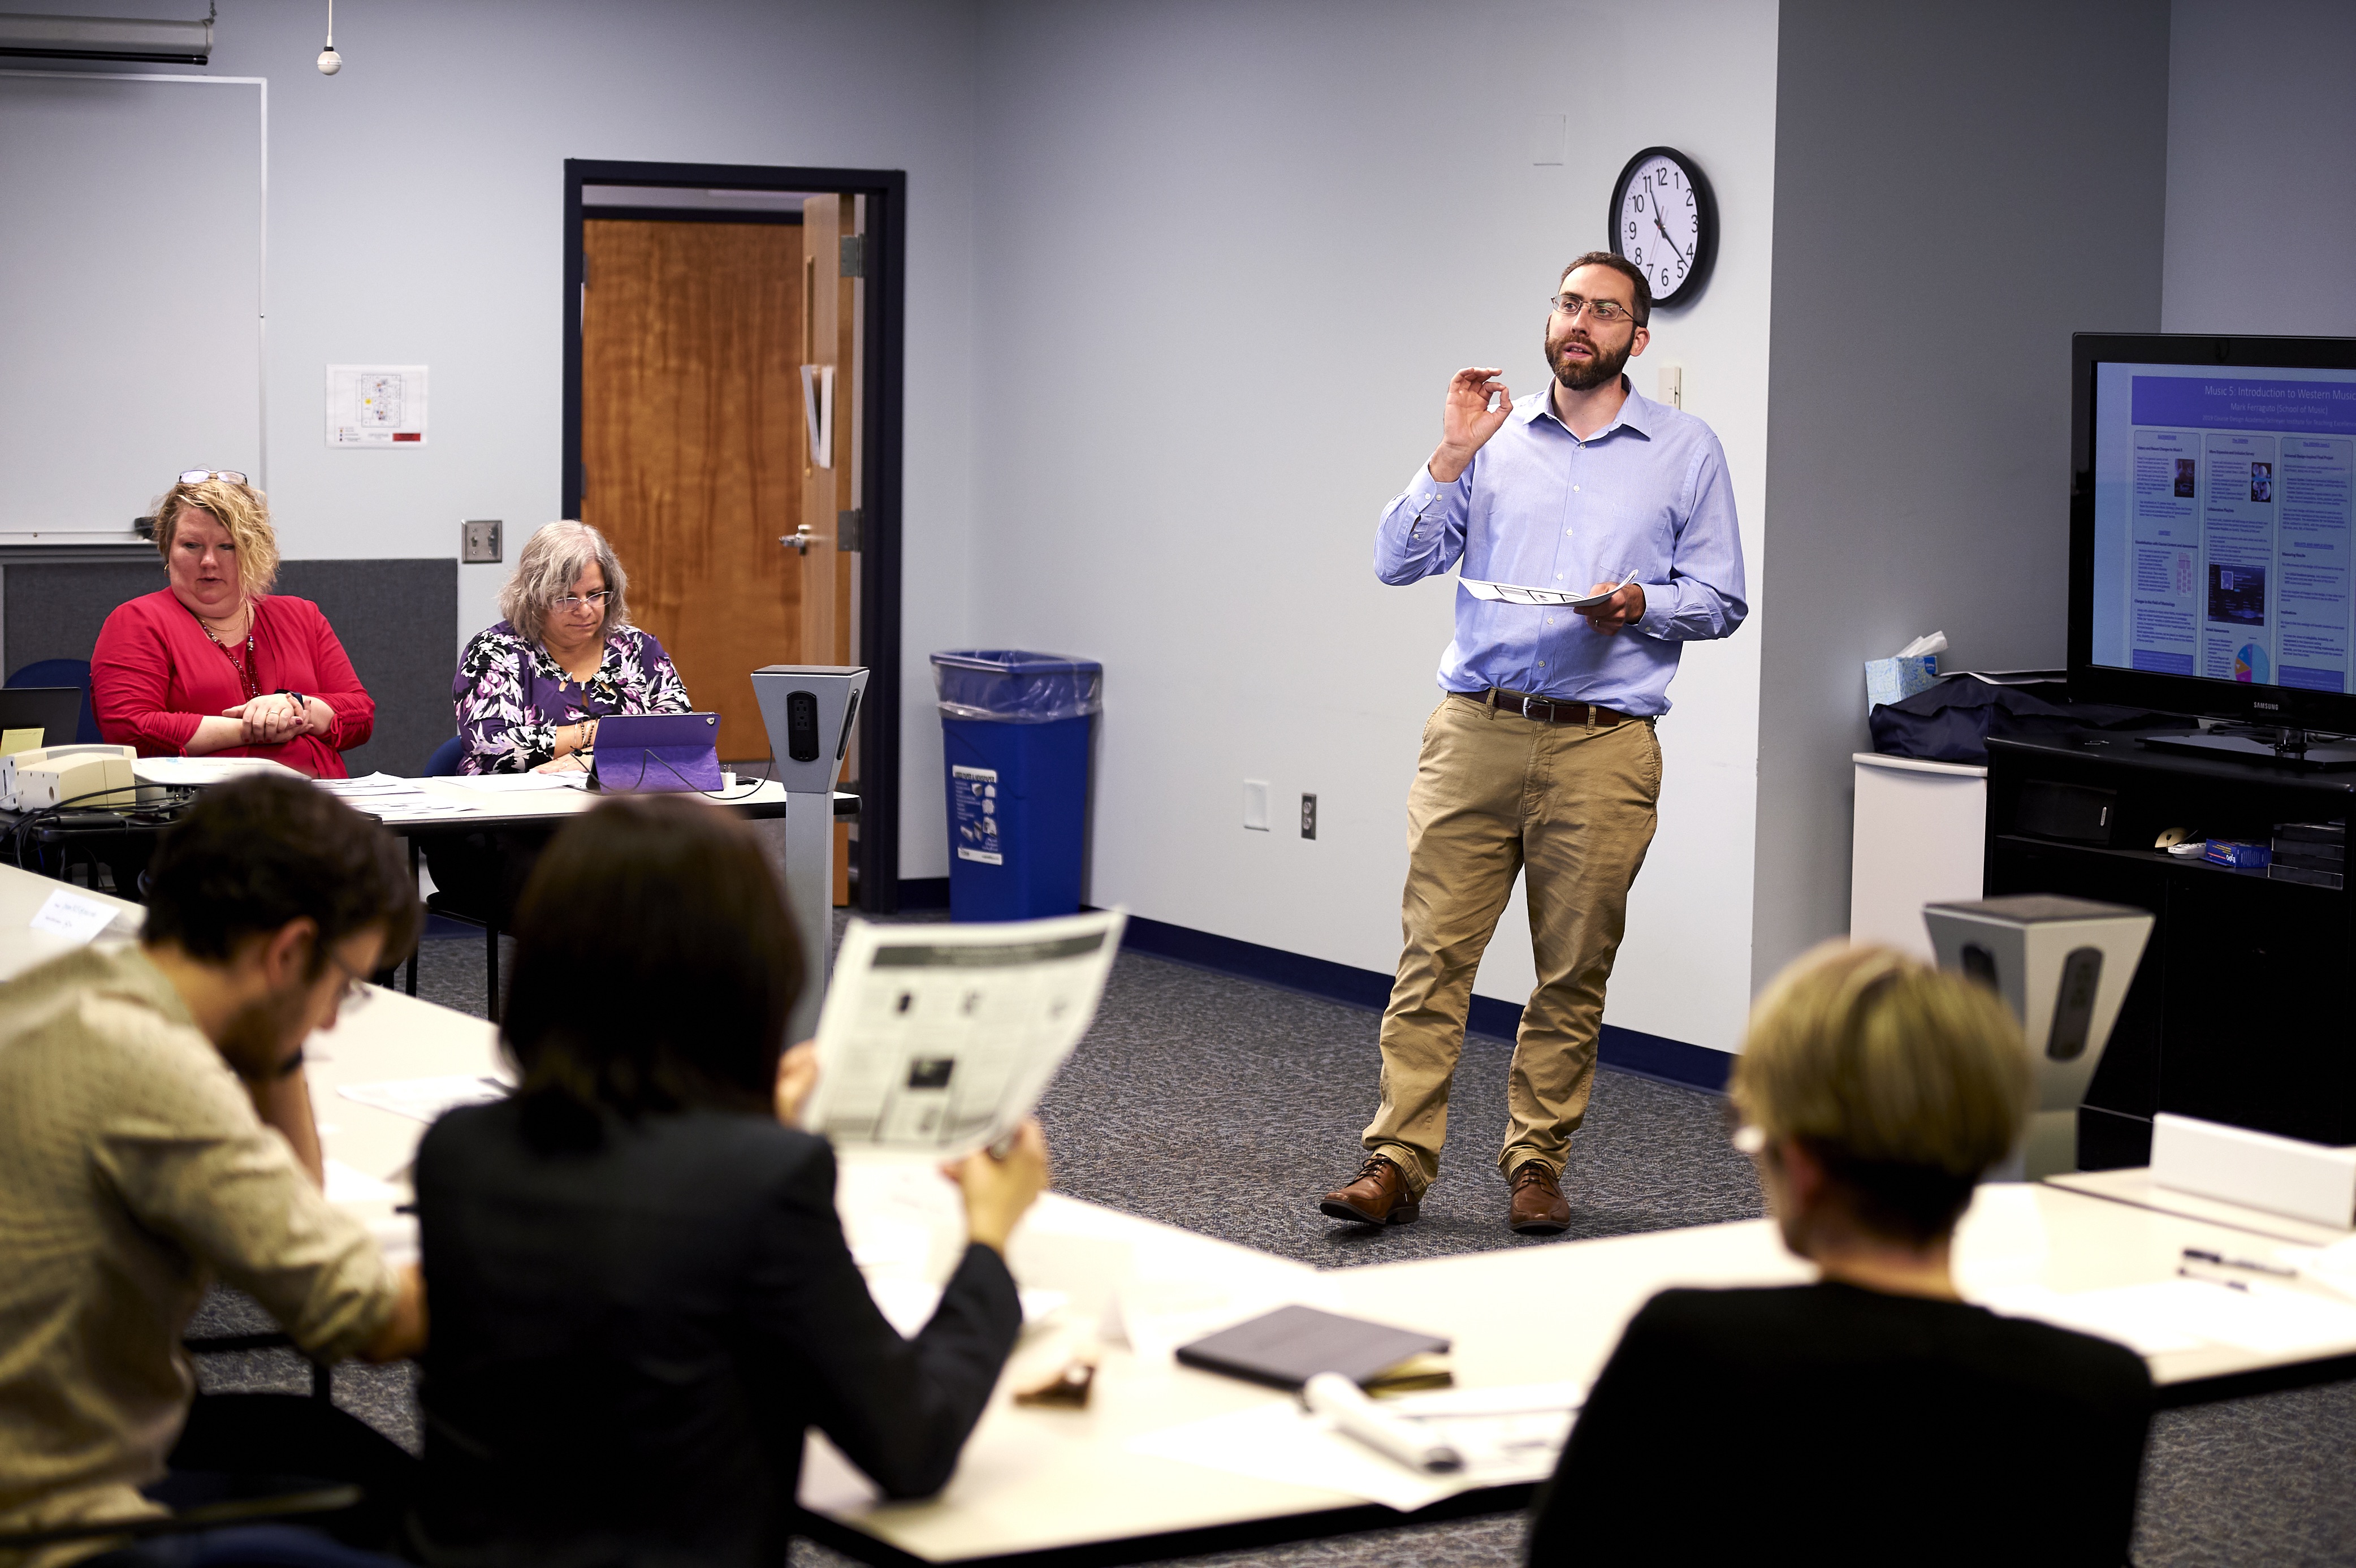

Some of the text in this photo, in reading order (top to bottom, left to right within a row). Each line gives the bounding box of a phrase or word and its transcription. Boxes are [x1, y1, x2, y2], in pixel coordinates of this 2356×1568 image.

[1642, 175, 1652, 193] 11
[1656, 167, 1668, 186] 12
[1674, 172, 1679, 189] 1
[1632, 194, 1644, 213] 10
[1686, 188, 1693, 206] 2
[1629, 222, 1637, 240] 9
[1691, 214, 1698, 233] 3
[1635, 247, 1642, 265] 8
[1686, 243, 1694, 260] 4
[1646, 264, 1654, 282] 7
[1661, 268, 1668, 286] 6
[1677, 260, 1684, 278] 5
[2205, 385, 2356, 400] Music 5: Introduction to Western Music
[2247, 403, 2275, 413] Ferraguto
[2277, 403, 2298, 414] (School
[2308, 405, 2328, 416] Music)
[2254, 702, 2279, 710] SAMSUNG
